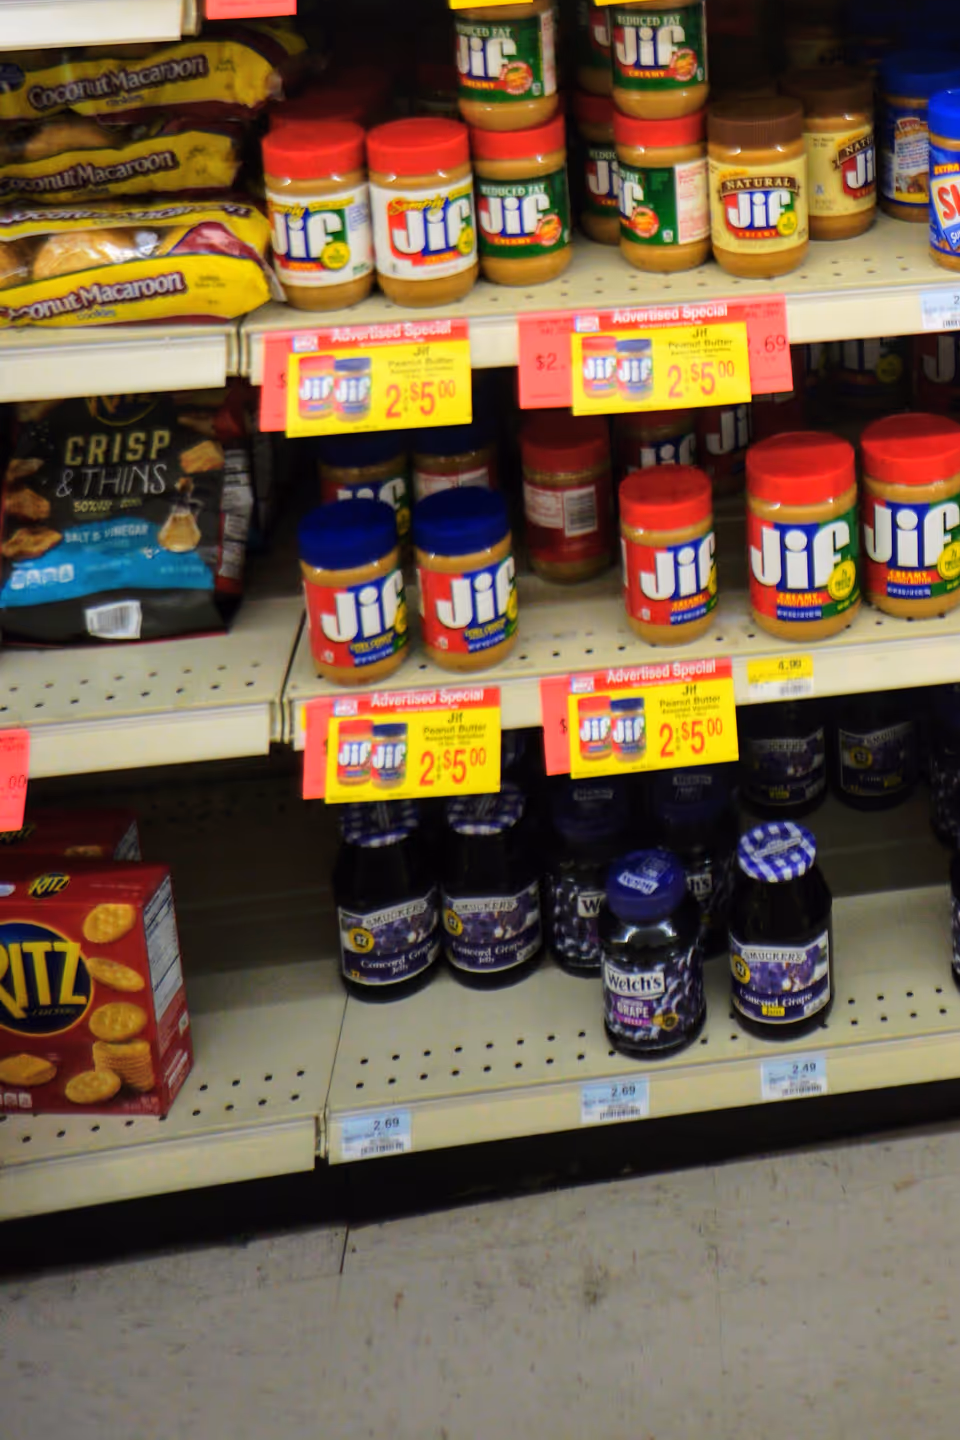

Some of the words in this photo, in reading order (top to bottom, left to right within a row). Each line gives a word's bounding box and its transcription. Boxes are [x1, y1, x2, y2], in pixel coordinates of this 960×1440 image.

[617, 15, 660, 26] REDUCED
[663, 14, 681, 26] FAT
[457, 36, 517, 78] Jif
[615, 26, 685, 67] Jif
[28, 78, 109, 110] Coconut
[110, 55, 209, 90] Macaroon
[79, 151, 175, 185] Macaroon
[934, 161, 959, 175] EXTRA
[481, 185, 525, 197] REDUCED
[527, 183, 546, 195] FAT
[726, 176, 791, 190] NATURAL
[481, 195, 551, 234] Jif
[727, 190, 790, 228] Jif
[271, 210, 343, 258] Jif
[392, 200, 471, 255] Jif
[612, 308, 677, 325] Advertised
[678, 304, 728, 320] Special
[331, 324, 402, 343] Advertised
[405, 319, 452, 338] Special
[690, 326, 709, 341] Jif
[412, 344, 430, 358] Jif
[667, 339, 703, 351] Peanut
[705, 337, 734, 348] Butter
[386, 358, 426, 371] Peanut
[428, 356, 455, 369] Butter
[583, 355, 617, 380] Jif
[618, 359, 651, 384] Jif
[299, 375, 334, 402] Jif
[336, 375, 369, 404] Jif
[65, 429, 171, 466] CRISP
[56, 469, 73, 498] &
[82, 463, 169, 496] THINS
[864, 501, 960, 569] Jif
[640, 531, 716, 601] Jif
[750, 521, 851, 590] Jif
[436, 556, 514, 629] Jif
[321, 569, 403, 643] Jif
[607, 667, 668, 684] Advertised
[672, 659, 716, 677] Special
[370, 691, 439, 708] Advertised
[439, 688, 485, 704] Special
[659, 697, 691, 708] Peanut
[693, 695, 721, 706] Butter
[682, 685, 699, 697] Jif
[447, 712, 464, 724] Jif
[423, 726, 455, 737] Peanut
[456, 724, 487, 735] Butter
[578, 717, 611, 744] Jif
[612, 719, 644, 742] Jif
[337, 743, 372, 767] Jif
[372, 745, 404, 770] Jif
[29, 874, 71, 898] RITZ
[360, 957, 405, 970] Concord
[408, 944, 433, 962] Grape
[452, 944, 493, 957] Concord
[495, 939, 524, 954] Grape
[606, 968, 663, 994] Welch's
[739, 991, 779, 1005] Concord
[781, 990, 813, 1007] Grape
[616, 1003, 650, 1019] GRAPE
[792, 1062, 817, 1074] 2.49
[610, 1085, 636, 1098] 2.69
[373, 1118, 400, 1131] 2.69
